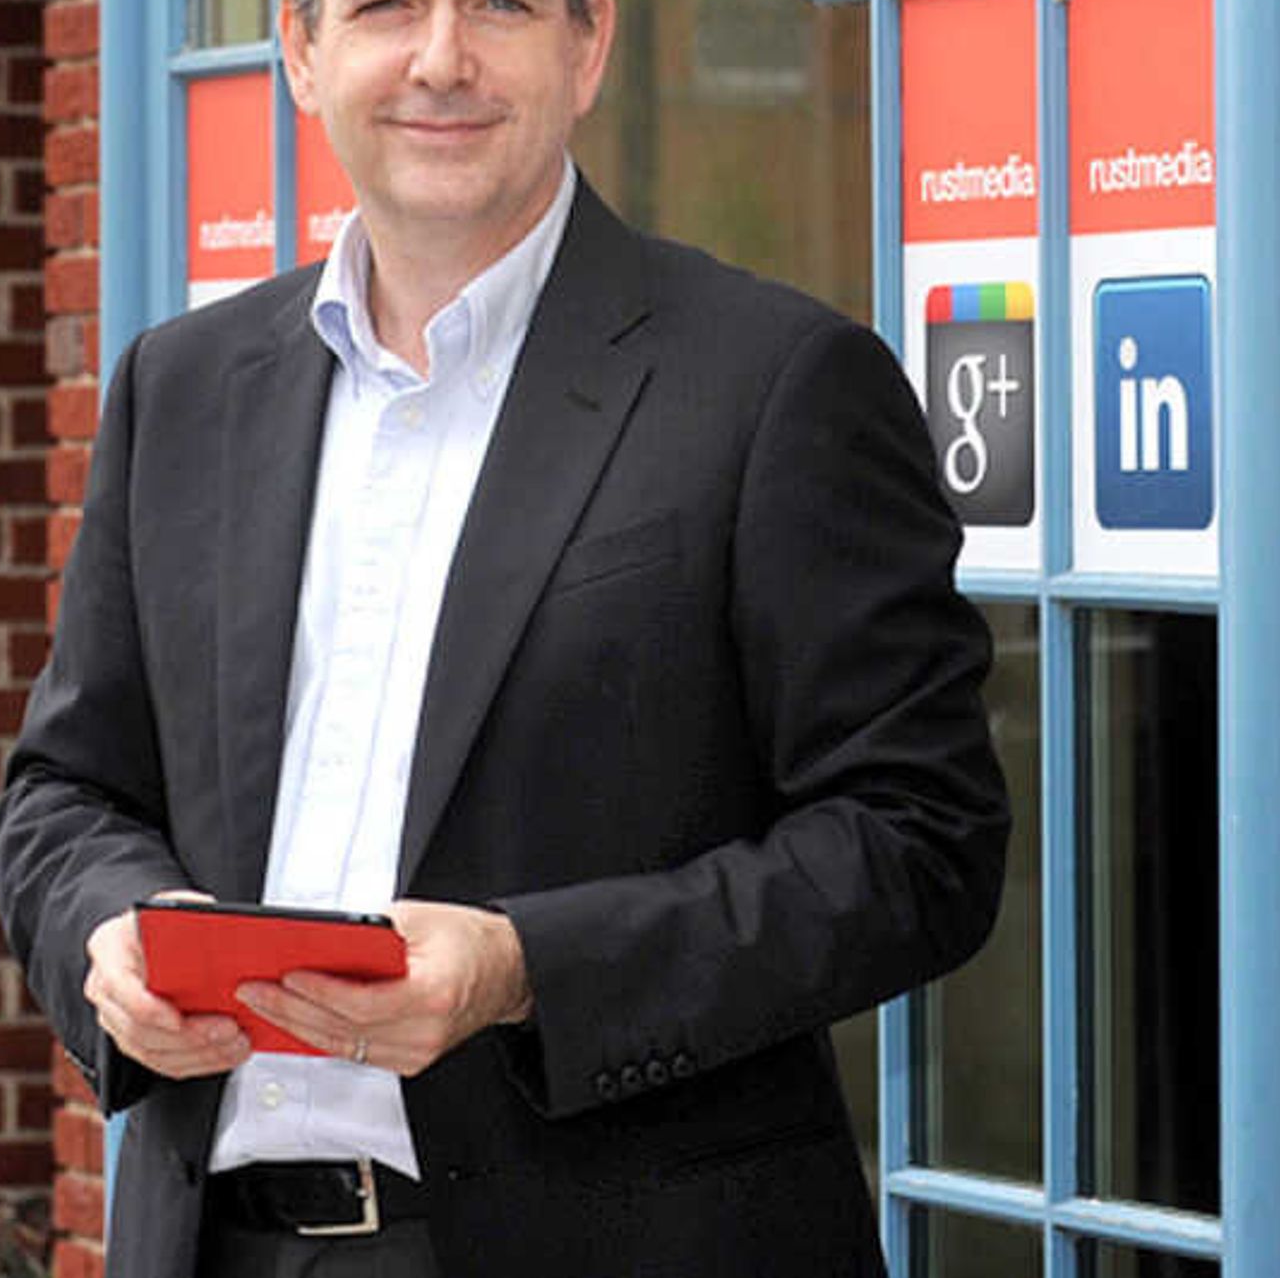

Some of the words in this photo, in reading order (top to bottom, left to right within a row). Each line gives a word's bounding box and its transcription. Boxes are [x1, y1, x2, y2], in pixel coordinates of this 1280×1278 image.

[920, 154, 1036, 202] rustmedia
[1089, 140, 1213, 194] rustmedia
[944, 352, 1020, 494] g+
[1118, 336, 1188, 472] in
